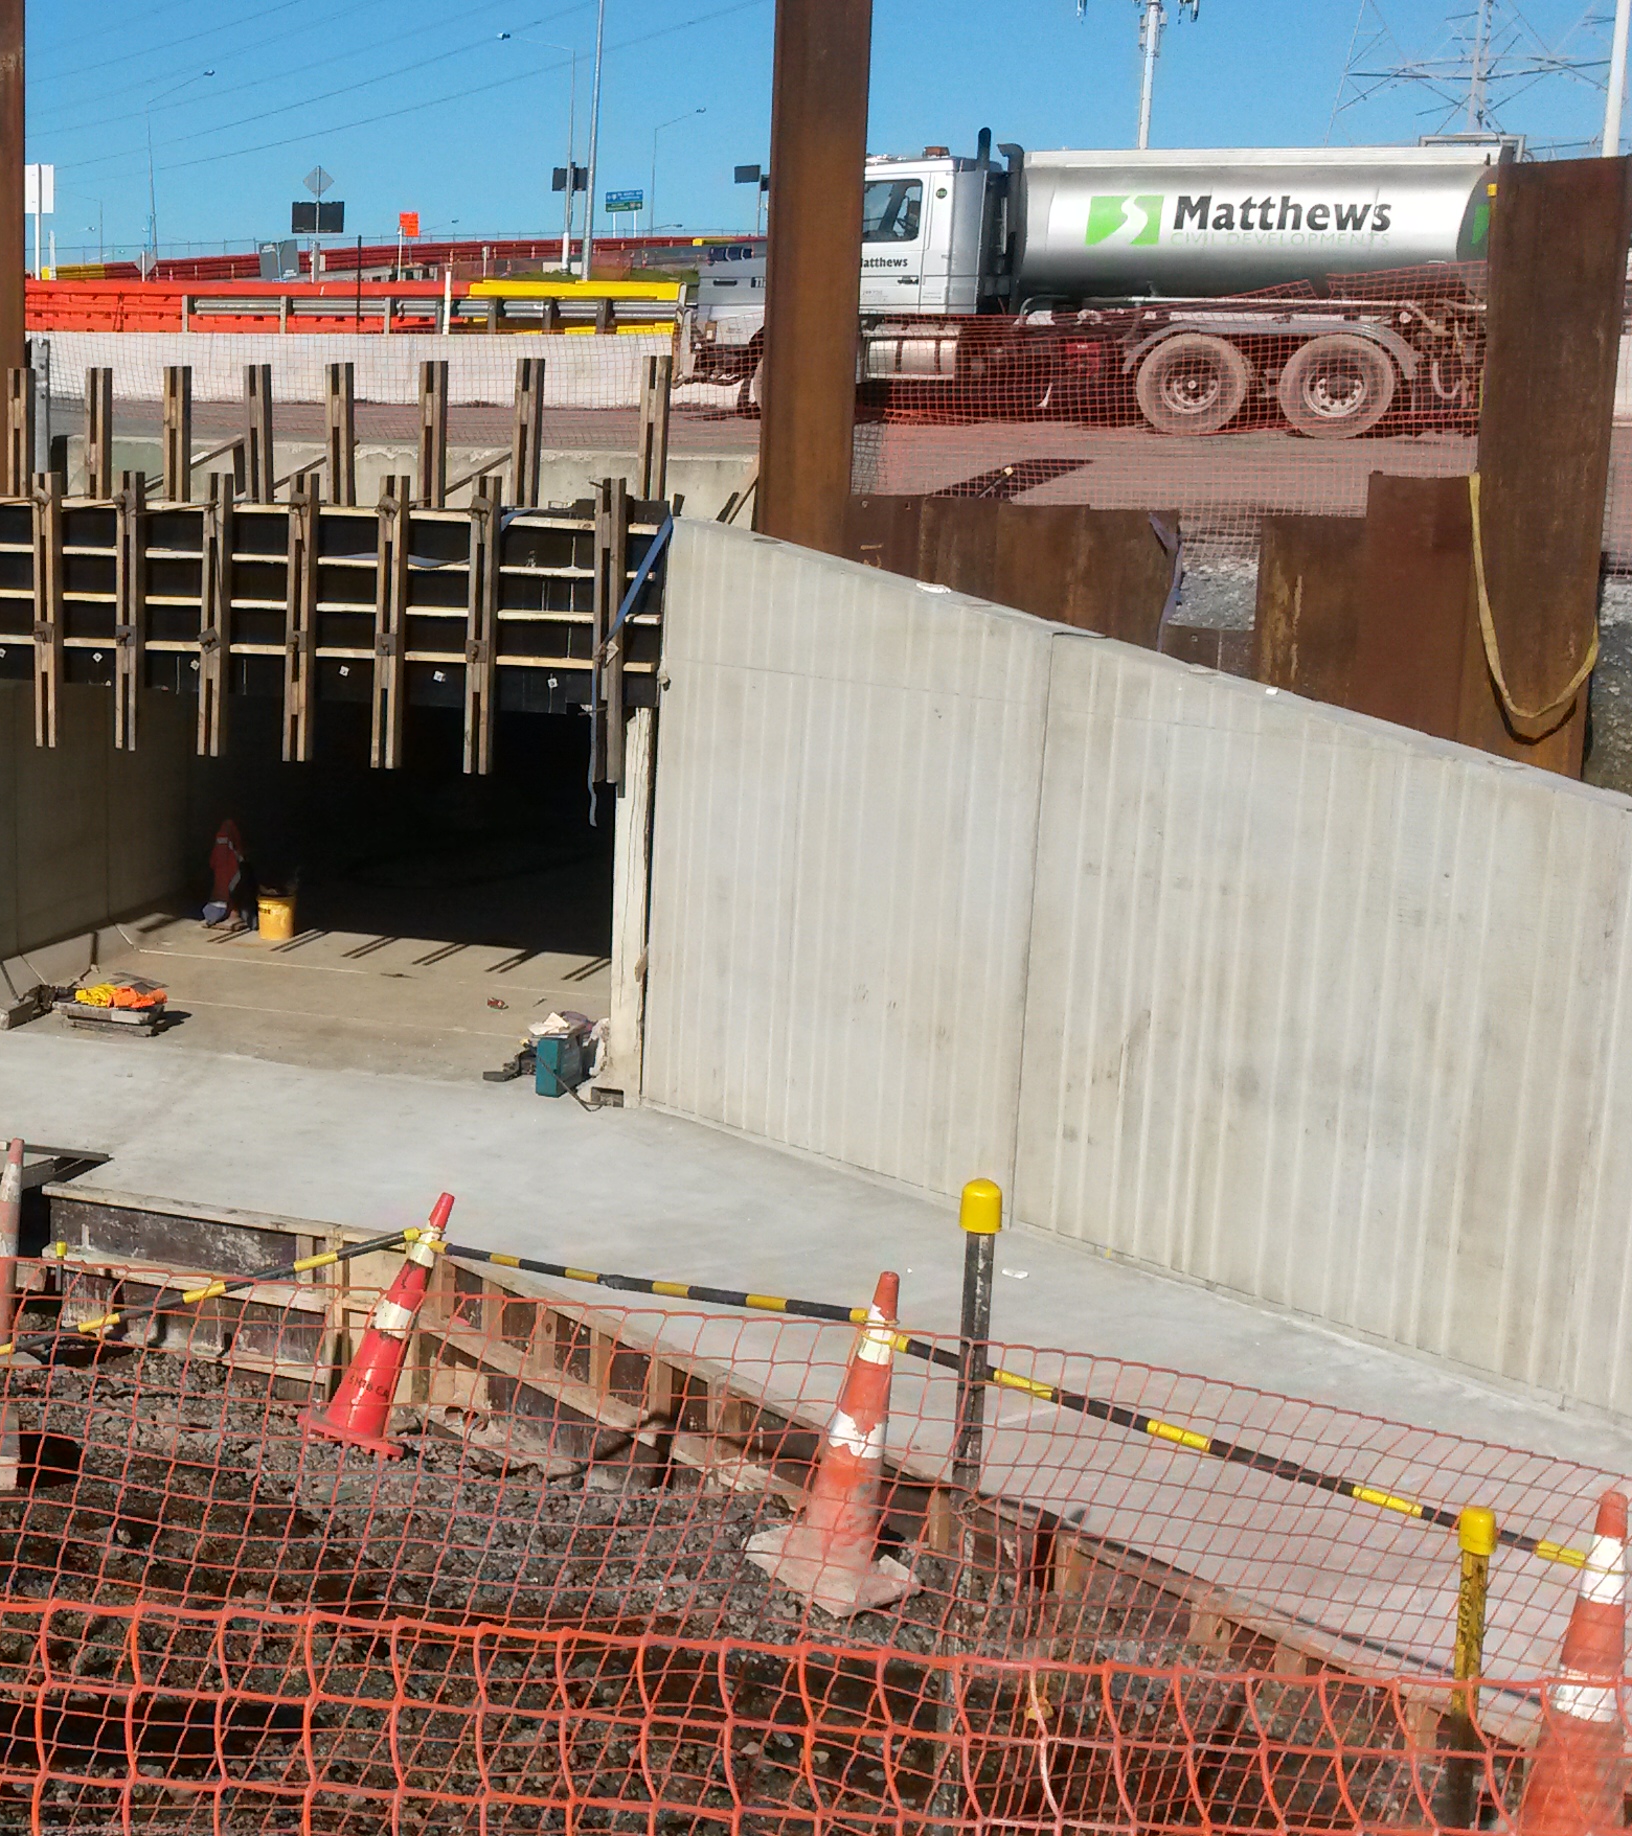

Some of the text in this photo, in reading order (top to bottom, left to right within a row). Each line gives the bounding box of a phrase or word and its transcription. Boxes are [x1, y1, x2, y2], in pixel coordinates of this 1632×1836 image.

[1173, 195, 1392, 231] Matthews
[1170, 232, 1390, 247] CIVIL DEVELOPMENTS
